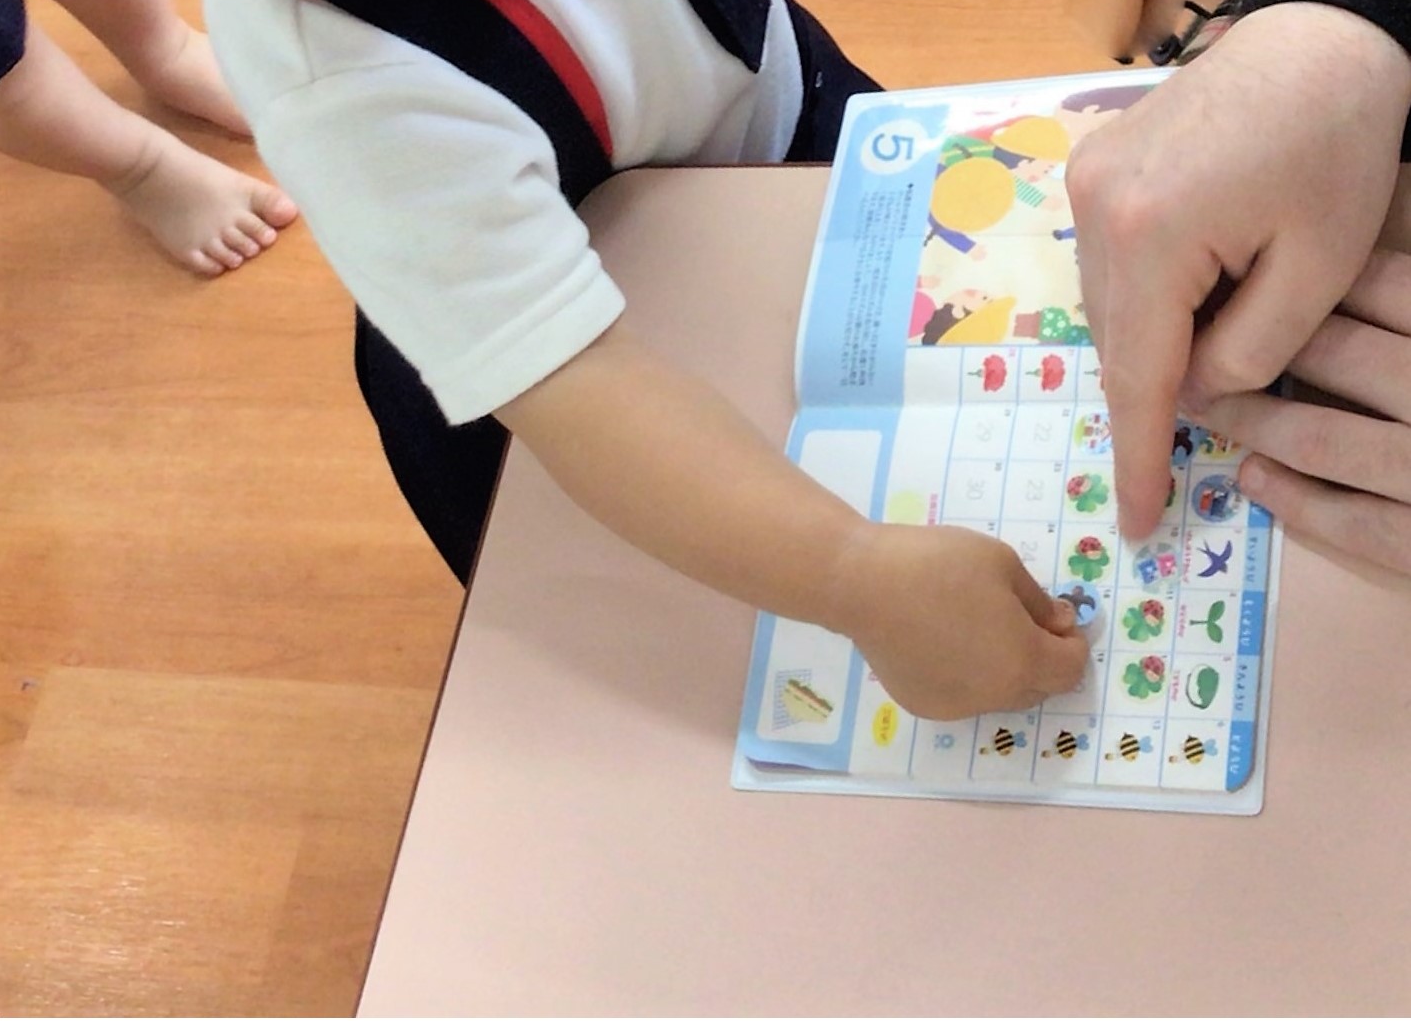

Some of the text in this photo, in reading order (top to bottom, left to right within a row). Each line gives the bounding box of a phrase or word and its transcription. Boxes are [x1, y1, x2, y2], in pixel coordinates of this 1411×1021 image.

[871, 131, 914, 162] 5
[1032, 421, 1053, 443] 22
[966, 479, 986, 501] 30
[1025, 479, 1045, 502] 23
